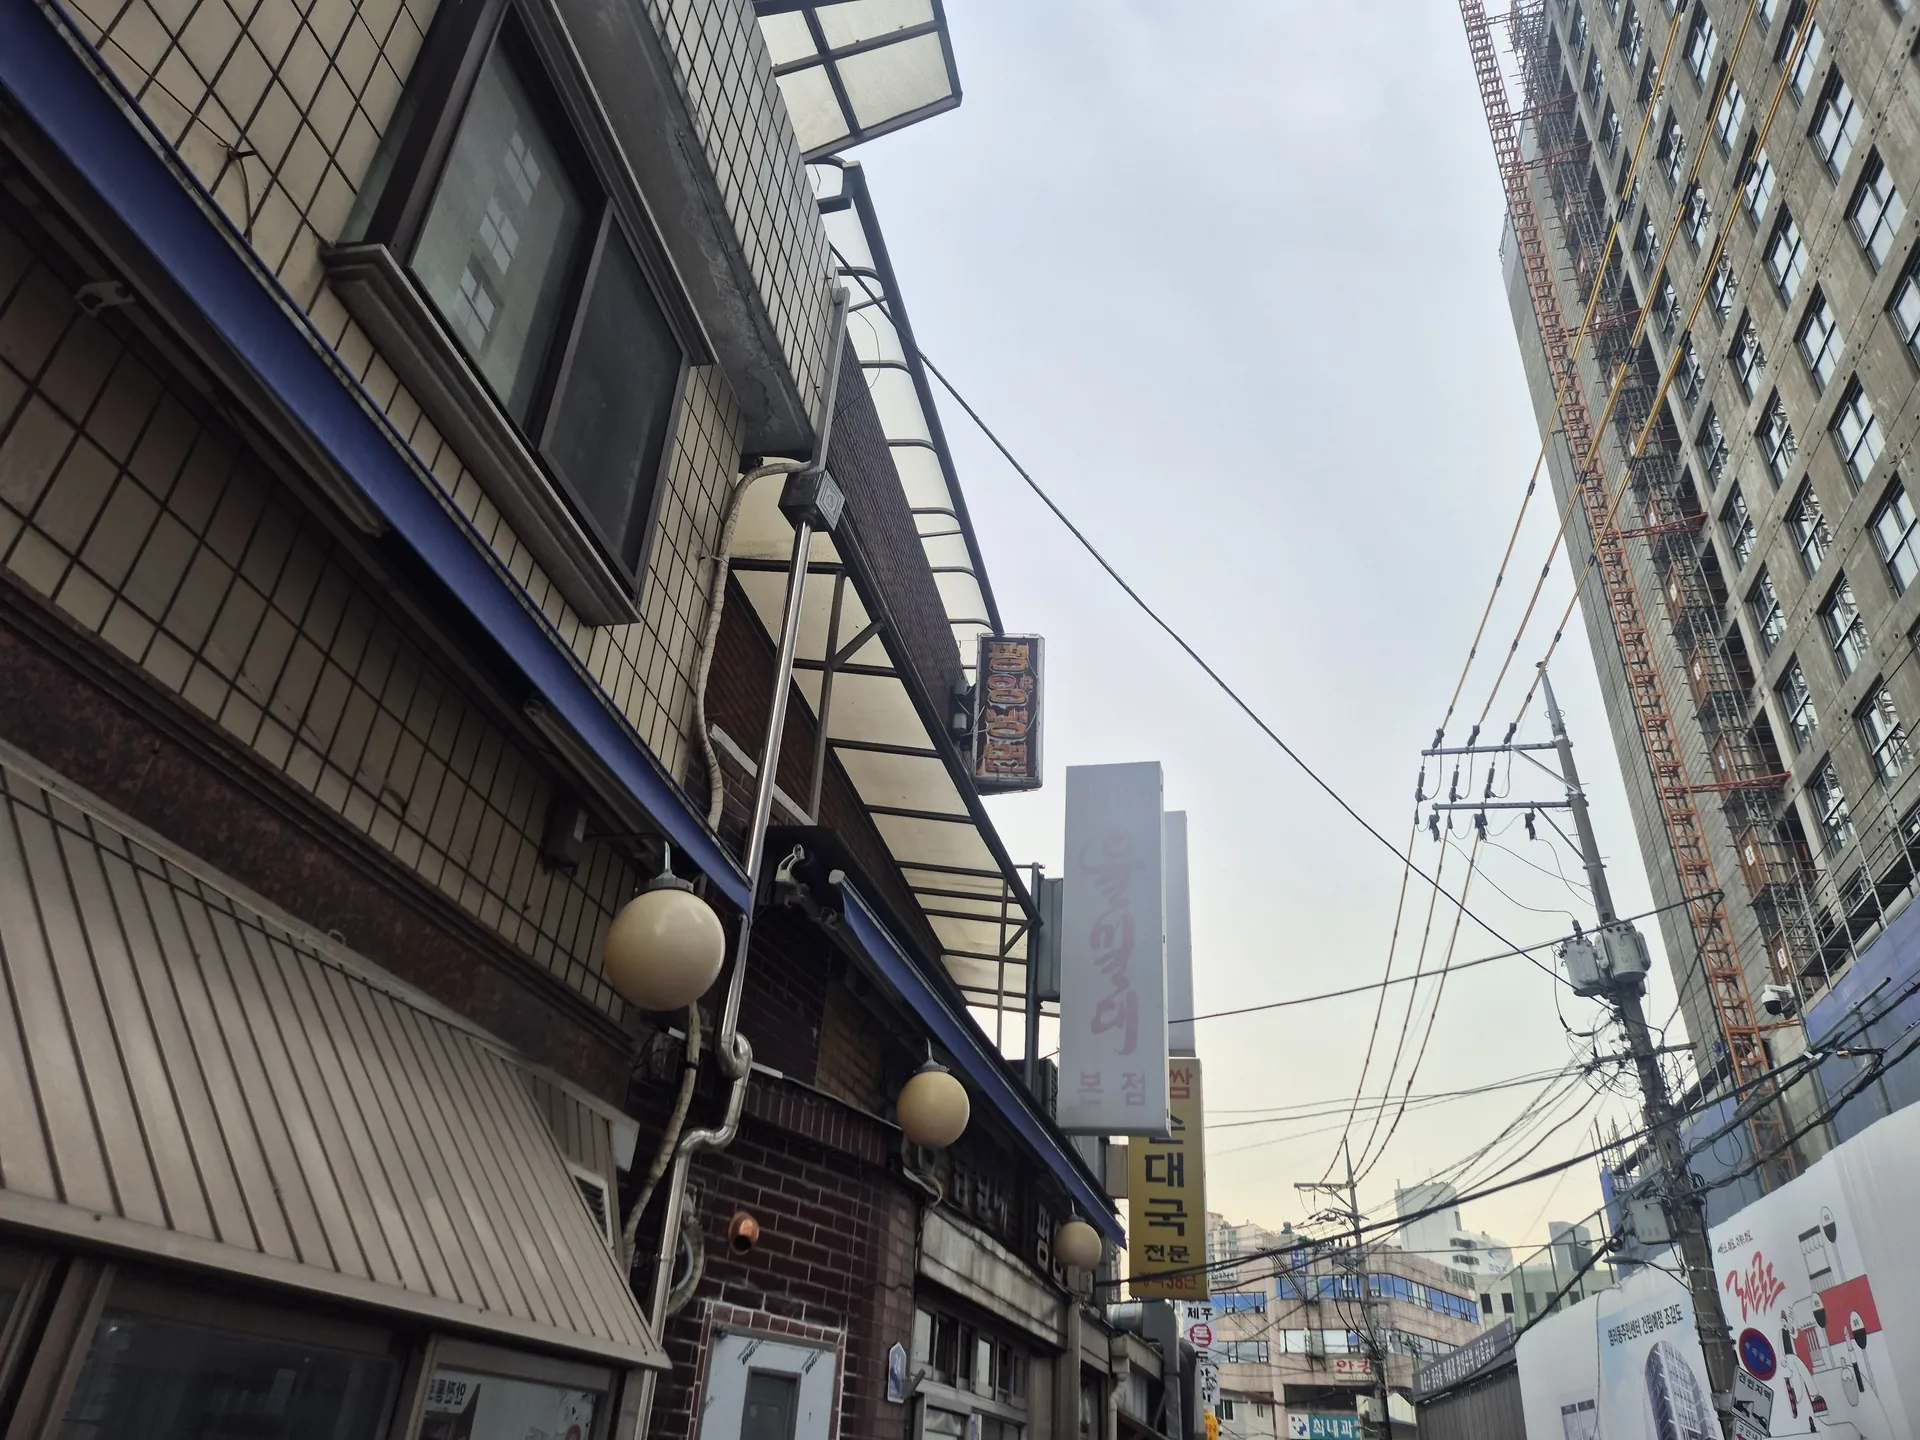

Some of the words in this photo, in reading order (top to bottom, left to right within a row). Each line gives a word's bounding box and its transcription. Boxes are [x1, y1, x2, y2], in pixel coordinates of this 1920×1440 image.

[1143, 1243, 1190, 1264] 전문
[1187, 1306, 1213, 1321] 제주
[1641, 1309, 1665, 1334] 건립예정
[1664, 1304, 1683, 1325] 조감도
[1738, 1372, 1771, 1401] 견인지역
